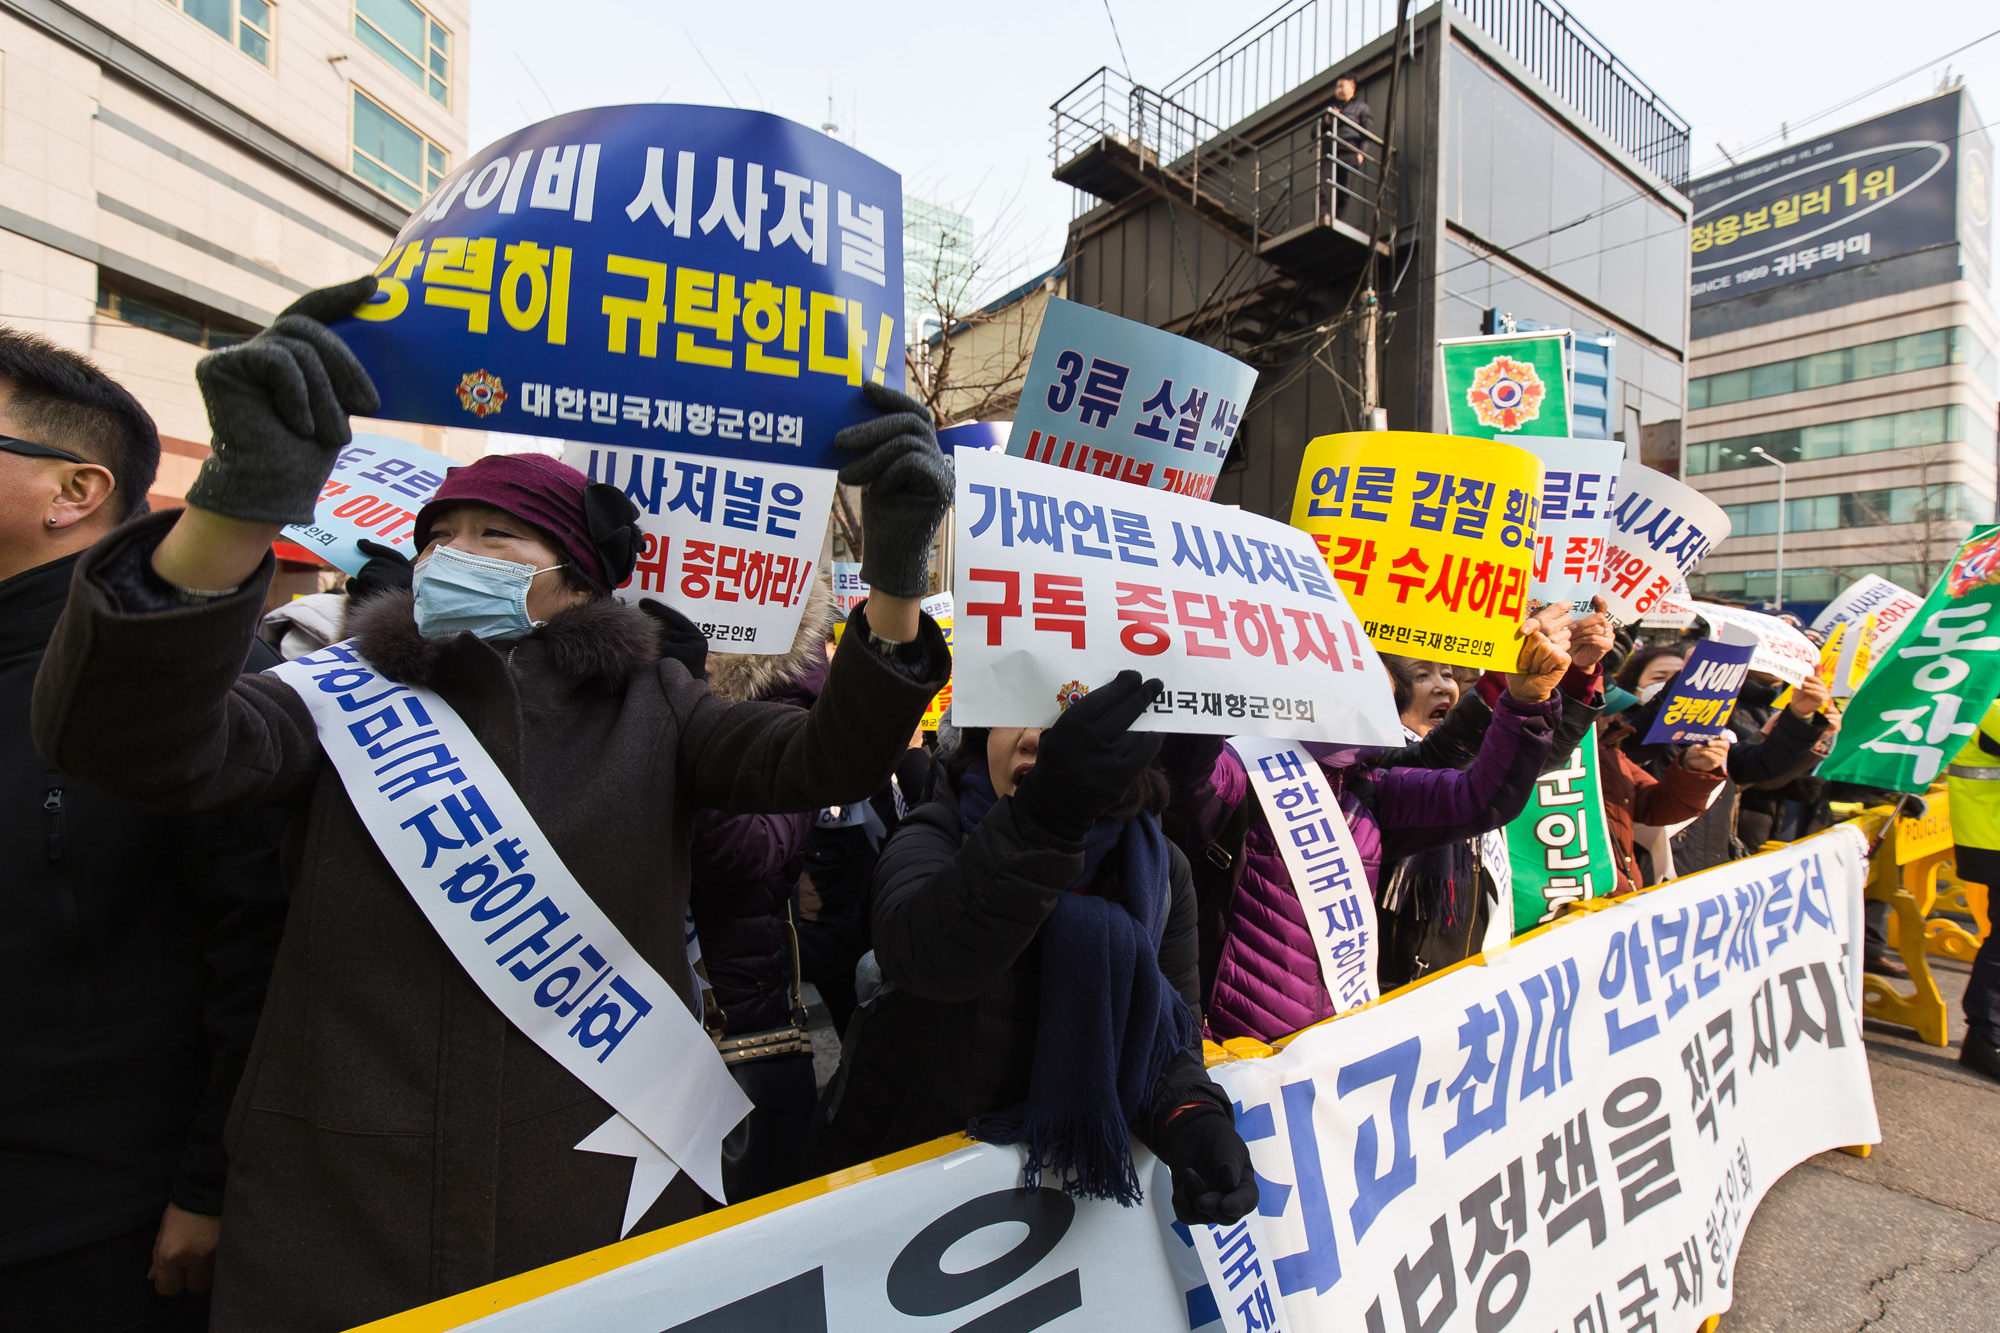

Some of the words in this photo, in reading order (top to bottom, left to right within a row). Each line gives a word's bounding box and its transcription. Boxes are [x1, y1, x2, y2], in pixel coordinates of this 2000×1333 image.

[624, 146, 887, 288] 시사저널
[1837, 165, 1896, 209] 1위
[1771, 232, 1872, 277] 귀뚜라미
[601, 253, 894, 388] 규탄한다!
[520, 381, 803, 447] 대한민국재향군인회
[1046, 349, 1132, 431] 3류
[1133, 378, 1209, 452] 소설
[357, 458, 444, 504] 모르
[1306, 466, 1397, 523] 언론
[1409, 469, 1497, 540] 갑질
[680, 538, 813, 608] 중단하라!
[968, 483, 1159, 568] 가짜언론
[1171, 520, 1339, 603] 시사저널
[966, 567, 1087, 651] 구독
[1115, 580, 1365, 674] 중단하자!
[1387, 546, 1528, 624] 수사하라
[1363, 619, 1495, 659] 대한민국재향군인회
[1141, 690, 1315, 723] 민국재향군인회
[1858, 602, 2000, 786] 동작
[1598, 853, 1837, 1056] 안보단체로서
